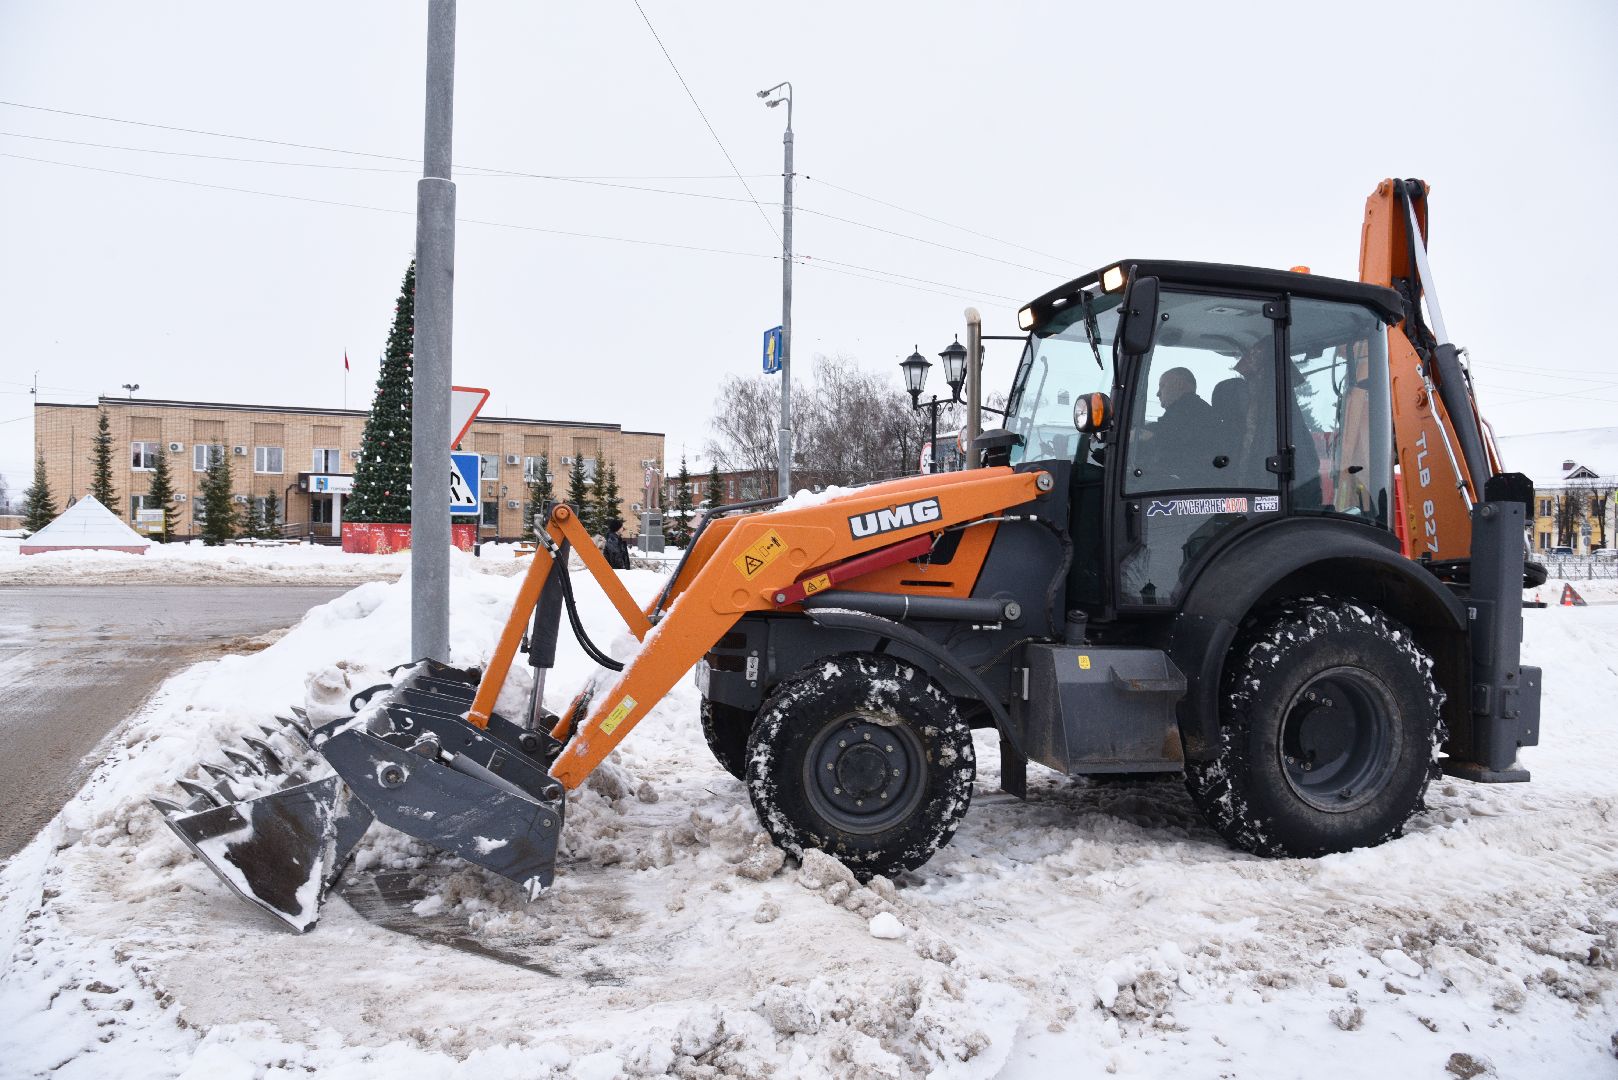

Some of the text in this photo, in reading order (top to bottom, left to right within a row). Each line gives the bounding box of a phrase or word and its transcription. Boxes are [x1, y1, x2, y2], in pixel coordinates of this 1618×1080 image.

[1177, 498, 1247, 515] РУСБИЗНЕСАВТО
[1416, 431, 1438, 552] TLB 827
[850, 500, 939, 536] UMG
